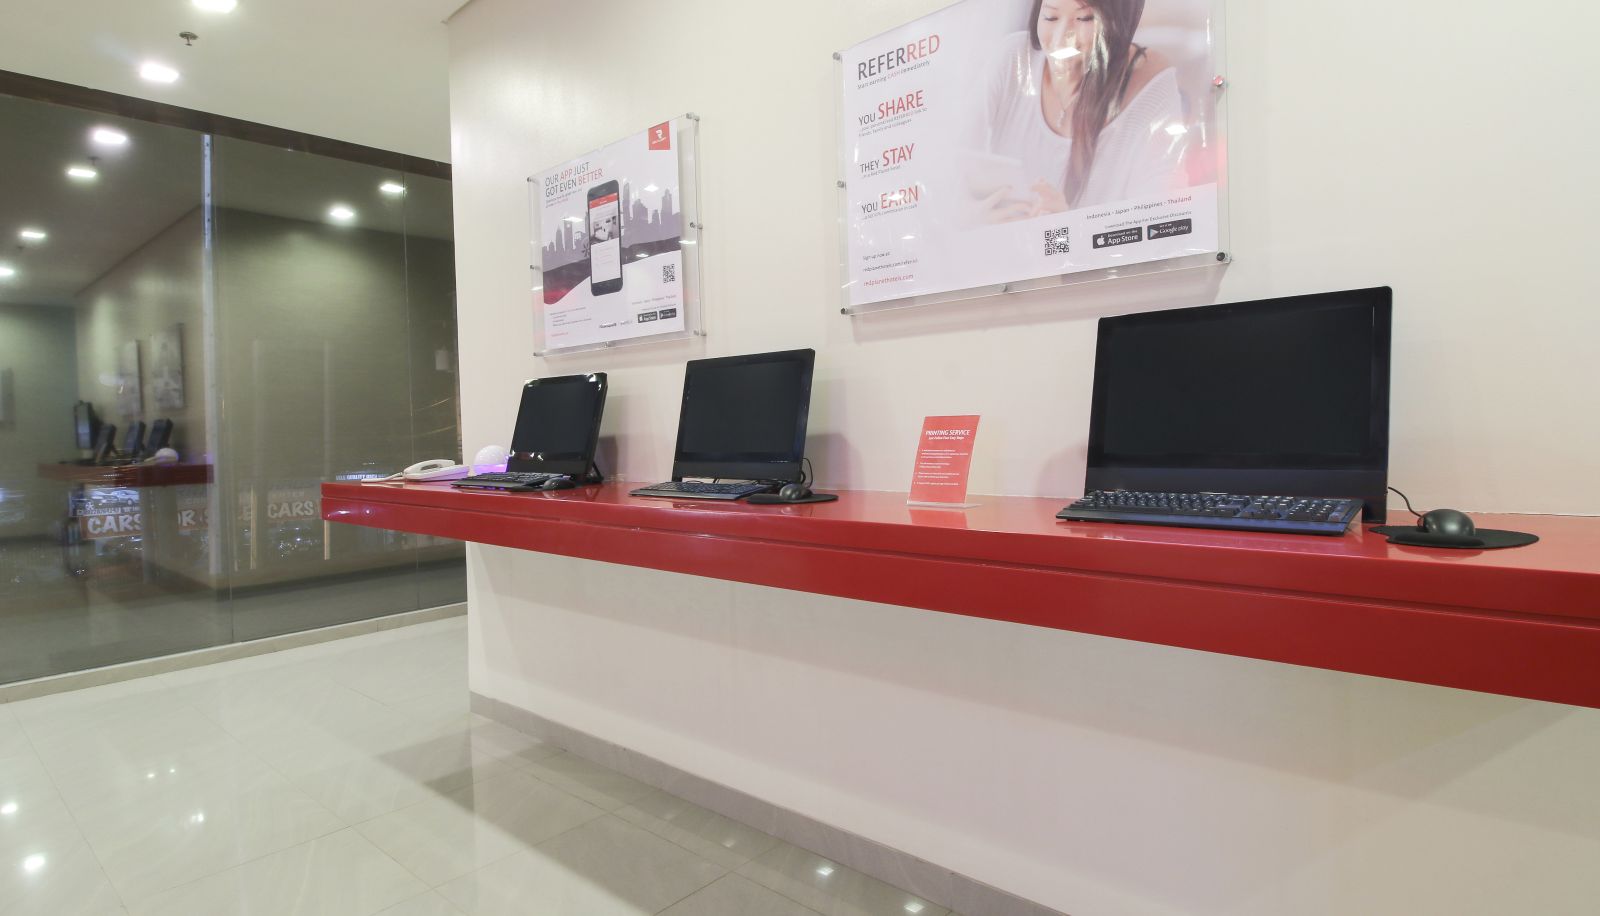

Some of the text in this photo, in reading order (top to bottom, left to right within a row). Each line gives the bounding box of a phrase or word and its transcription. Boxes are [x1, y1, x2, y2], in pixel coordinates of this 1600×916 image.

[858, 35, 940, 80] REFERRED
[869, 75, 887, 87] earning
[900, 60, 930, 75] immediately
[858, 112, 876, 126] YOU
[878, 89, 924, 120] SHARE
[859, 142, 914, 173] THEY STAY
[545, 162, 589, 187] OUR APP JUST
[545, 168, 604, 198] GOT EVEN BETTER
[861, 184, 919, 214] YOU EARN
[1086, 195, 1191, 220] Indonesia Japan Philippines Thailand
[1107, 233, 1139, 246] App Store
[1159, 224, 1189, 236] Google play
[267, 500, 315, 518] CARS
[87, 513, 143, 535] CARS
